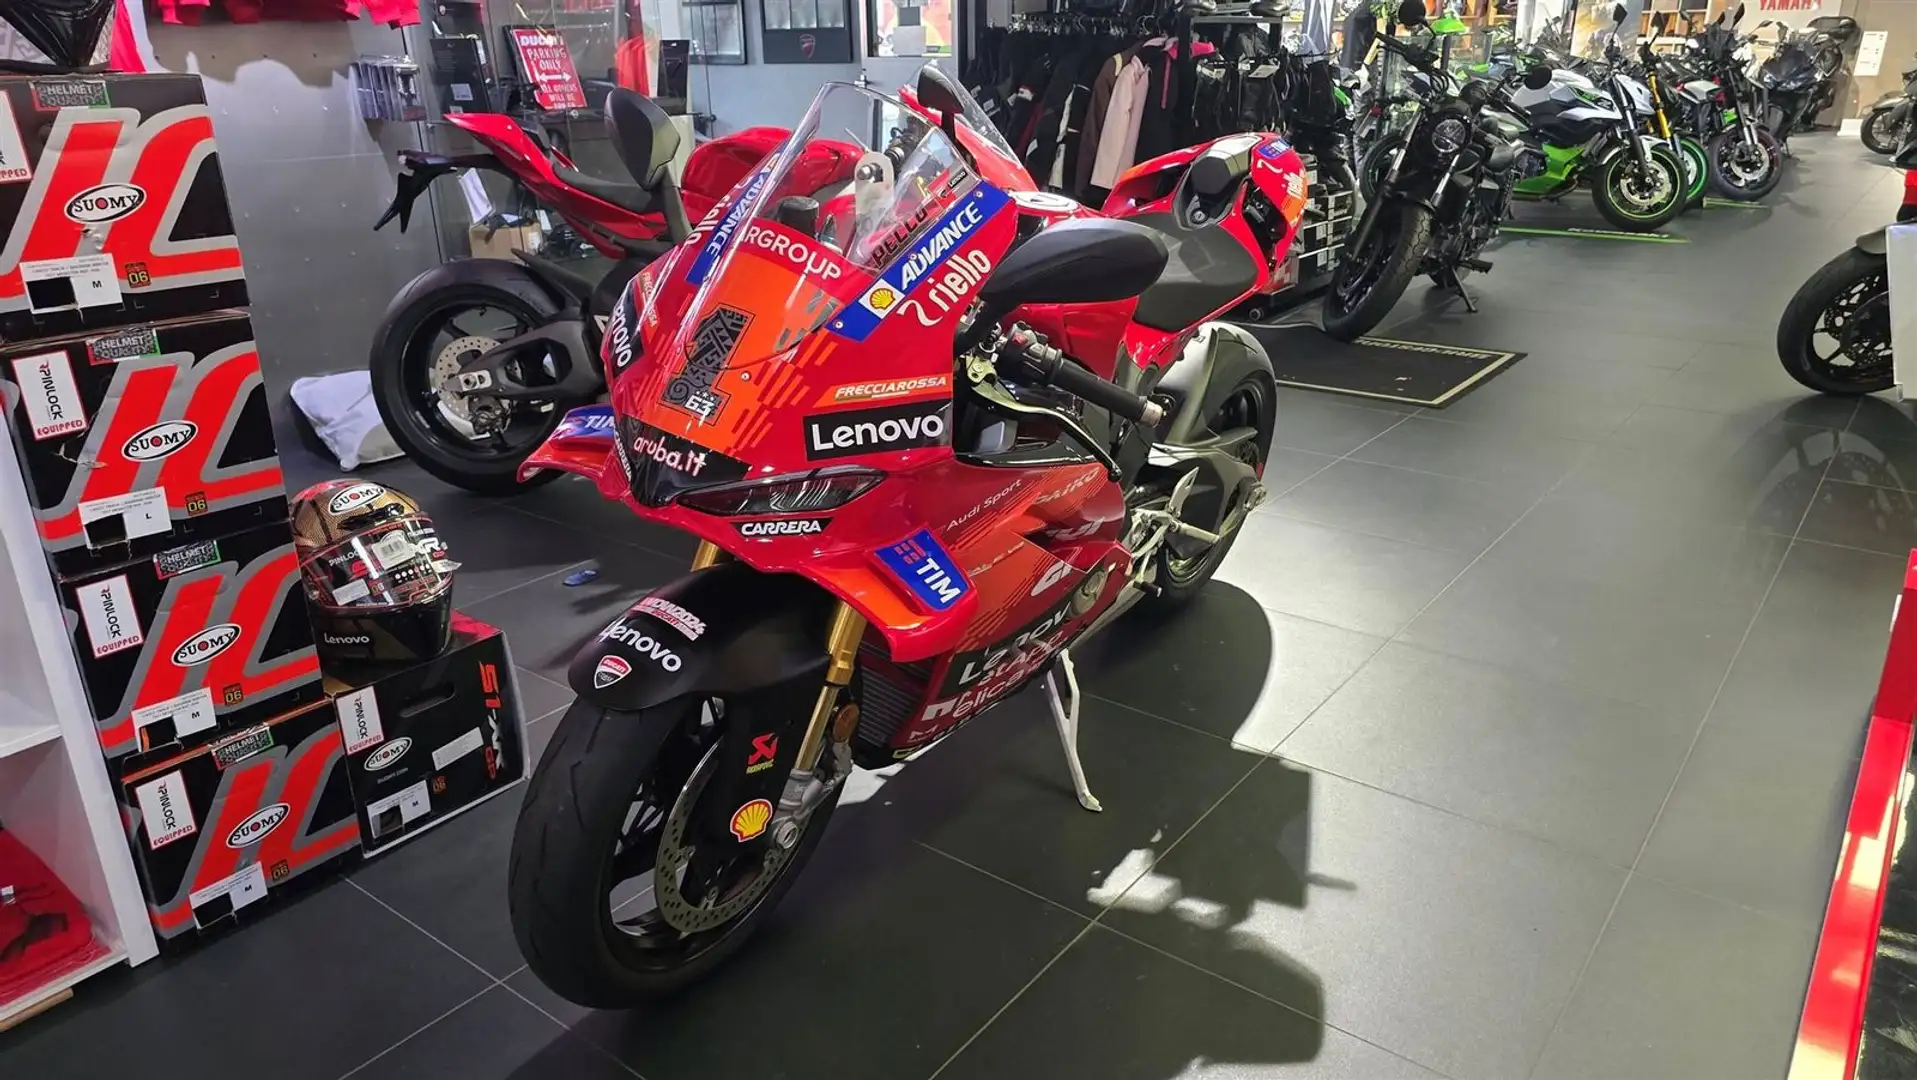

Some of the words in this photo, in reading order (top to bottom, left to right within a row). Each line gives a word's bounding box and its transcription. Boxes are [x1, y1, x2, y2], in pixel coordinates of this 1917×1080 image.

[521, 34, 564, 46] DUCTI
[47, 84, 93, 95] HELMET
[0, 168, 27, 178] PPED
[73, 193, 138, 213] SUOMY
[740, 225, 842, 280] RGROUP
[900, 201, 983, 291] ADVANCE
[92, 280, 102, 289] M
[128, 271, 149, 285] 06
[928, 249, 991, 312] riello
[102, 336, 144, 349] HELMET
[40, 367, 63, 420] PINLOCK
[835, 376, 947, 398] FRECCIAROSSA
[685, 395, 714, 418] 63
[37, 419, 83, 436] EQUIPPED
[812, 414, 944, 451] Lenovo
[131, 430, 190, 452] SUOMY
[633, 436, 707, 477] aruba.it
[188, 500, 206, 512] 06
[333, 486, 384, 509] SUOMY
[946, 505, 980, 531] Audi
[984, 479, 1022, 508] Sport
[145, 512, 152, 520] L
[741, 519, 821, 535] CARRERA
[329, 550, 359, 567] PINLOC
[916, 557, 961, 604] TIM
[101, 591, 121, 638] PINLOCK
[97, 635, 140, 654] EQUIPPED
[179, 632, 235, 659] SUOMY
[324, 632, 370, 644] Lenovo
[597, 617, 682, 673] Lenovo
[225, 689, 242, 704] 06
[191, 711, 201, 720] M
[370, 742, 408, 766] SUOMY
[158, 786, 176, 829] PINLOCK
[153, 824, 194, 846] EQUIPPED
[233, 810, 284, 842] SUOMY
[244, 883, 253, 892] M
